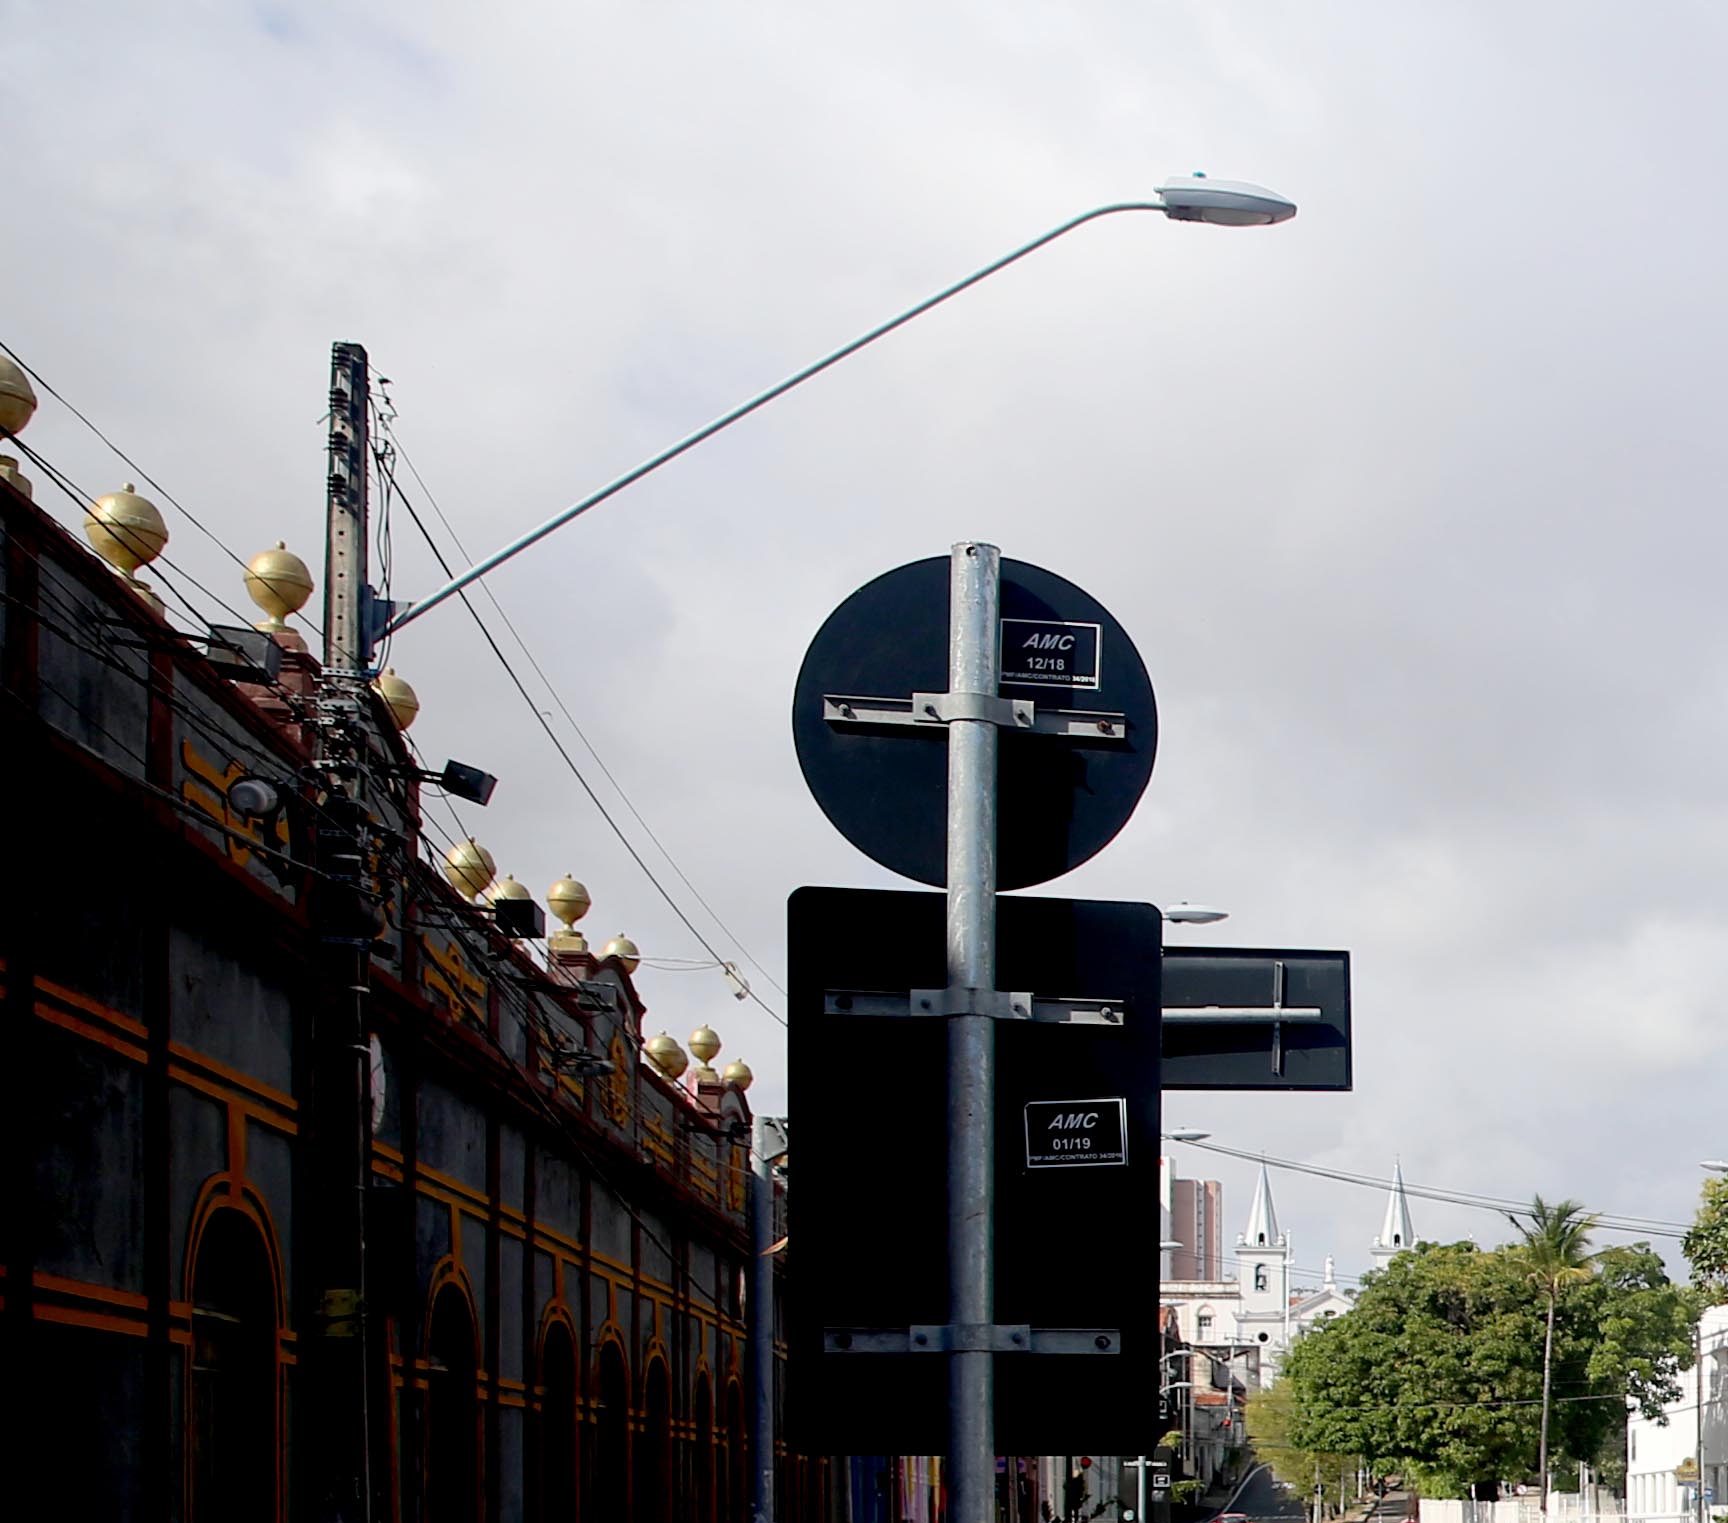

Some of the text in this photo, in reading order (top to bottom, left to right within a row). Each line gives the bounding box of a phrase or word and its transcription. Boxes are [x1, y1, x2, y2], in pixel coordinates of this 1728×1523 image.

[1022, 633, 1075, 650] AMC
[1026, 657, 1065, 670] 12/18
[1048, 1112, 1099, 1129] AMC
[1053, 1138, 1091, 1150] 01/19
